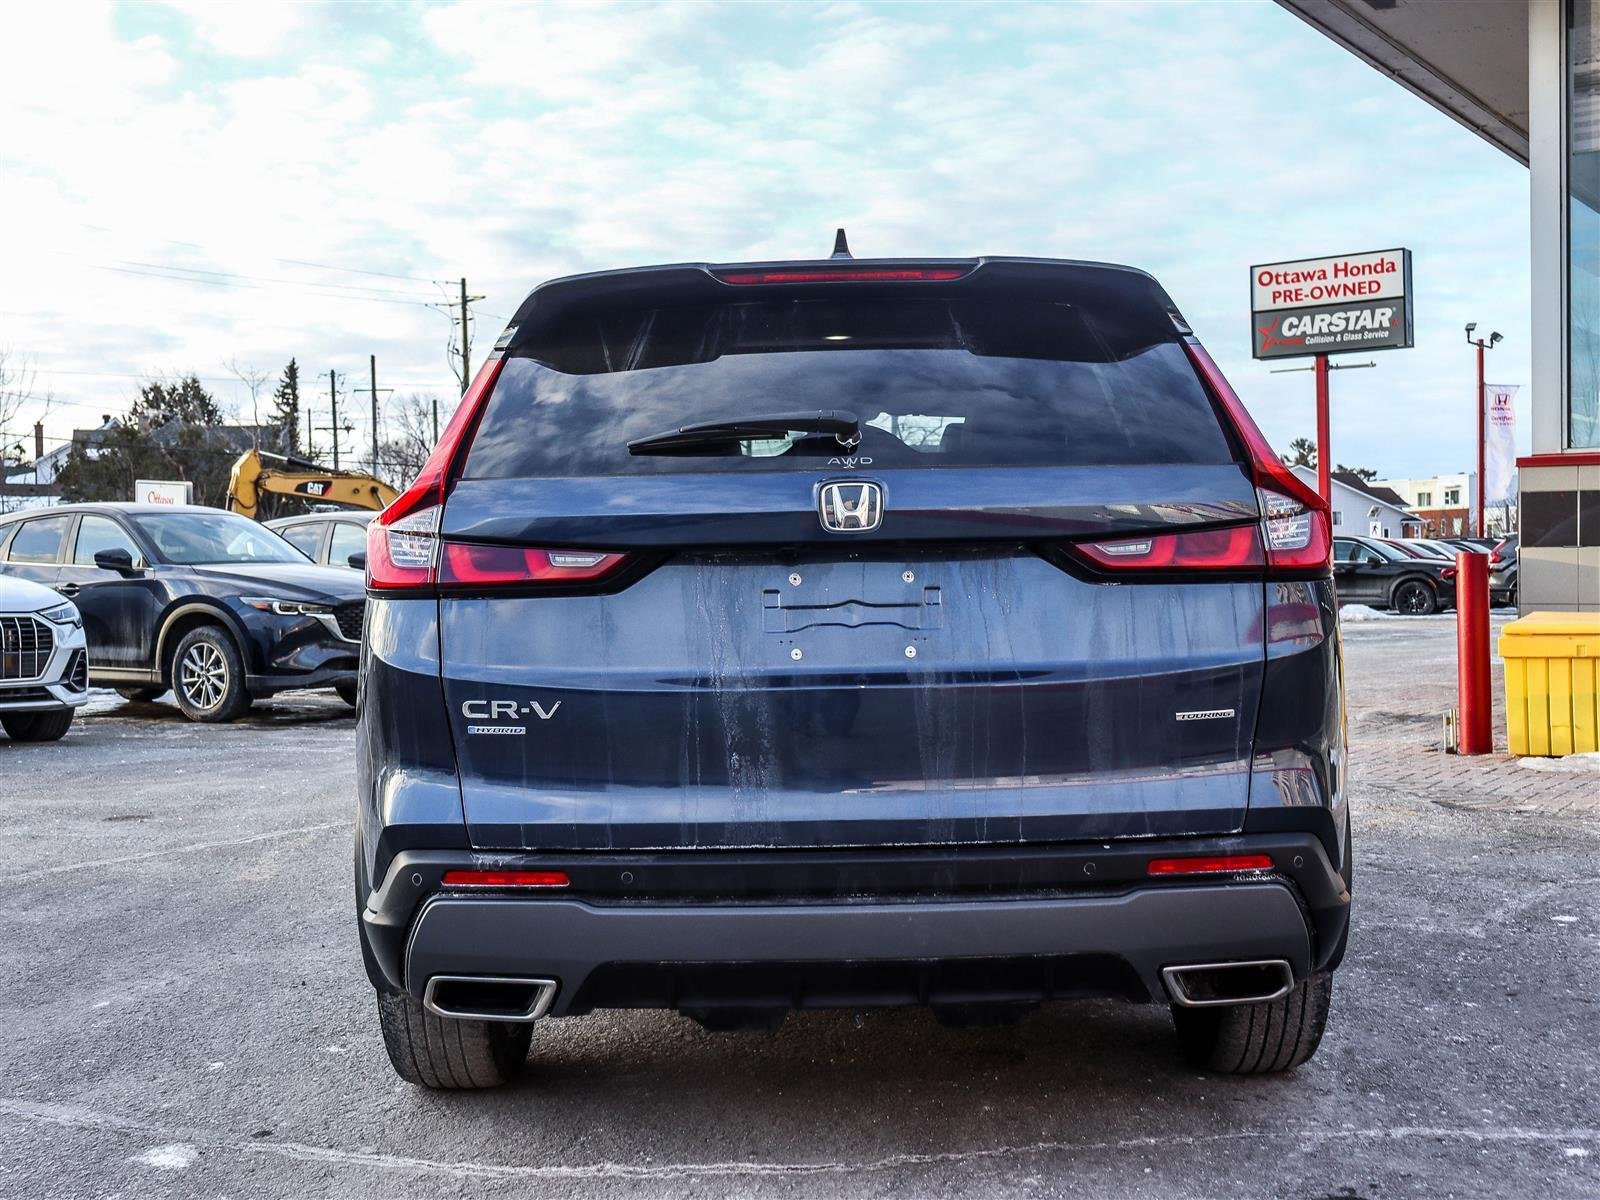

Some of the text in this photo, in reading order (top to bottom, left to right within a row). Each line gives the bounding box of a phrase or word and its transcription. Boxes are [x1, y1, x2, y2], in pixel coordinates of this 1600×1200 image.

[1258, 257, 1397, 287] Ottawa Honda
[1272, 280, 1381, 304] PRE-OWNED
[1281, 307, 1393, 337] CARSTAR
[1305, 330, 1389, 345] Collision & Glass Service
[827, 457, 873, 465] AWD
[307, 482, 324, 496] CAT
[461, 700, 562, 720] CR-V
[1181, 712, 1231, 720] TOURING
